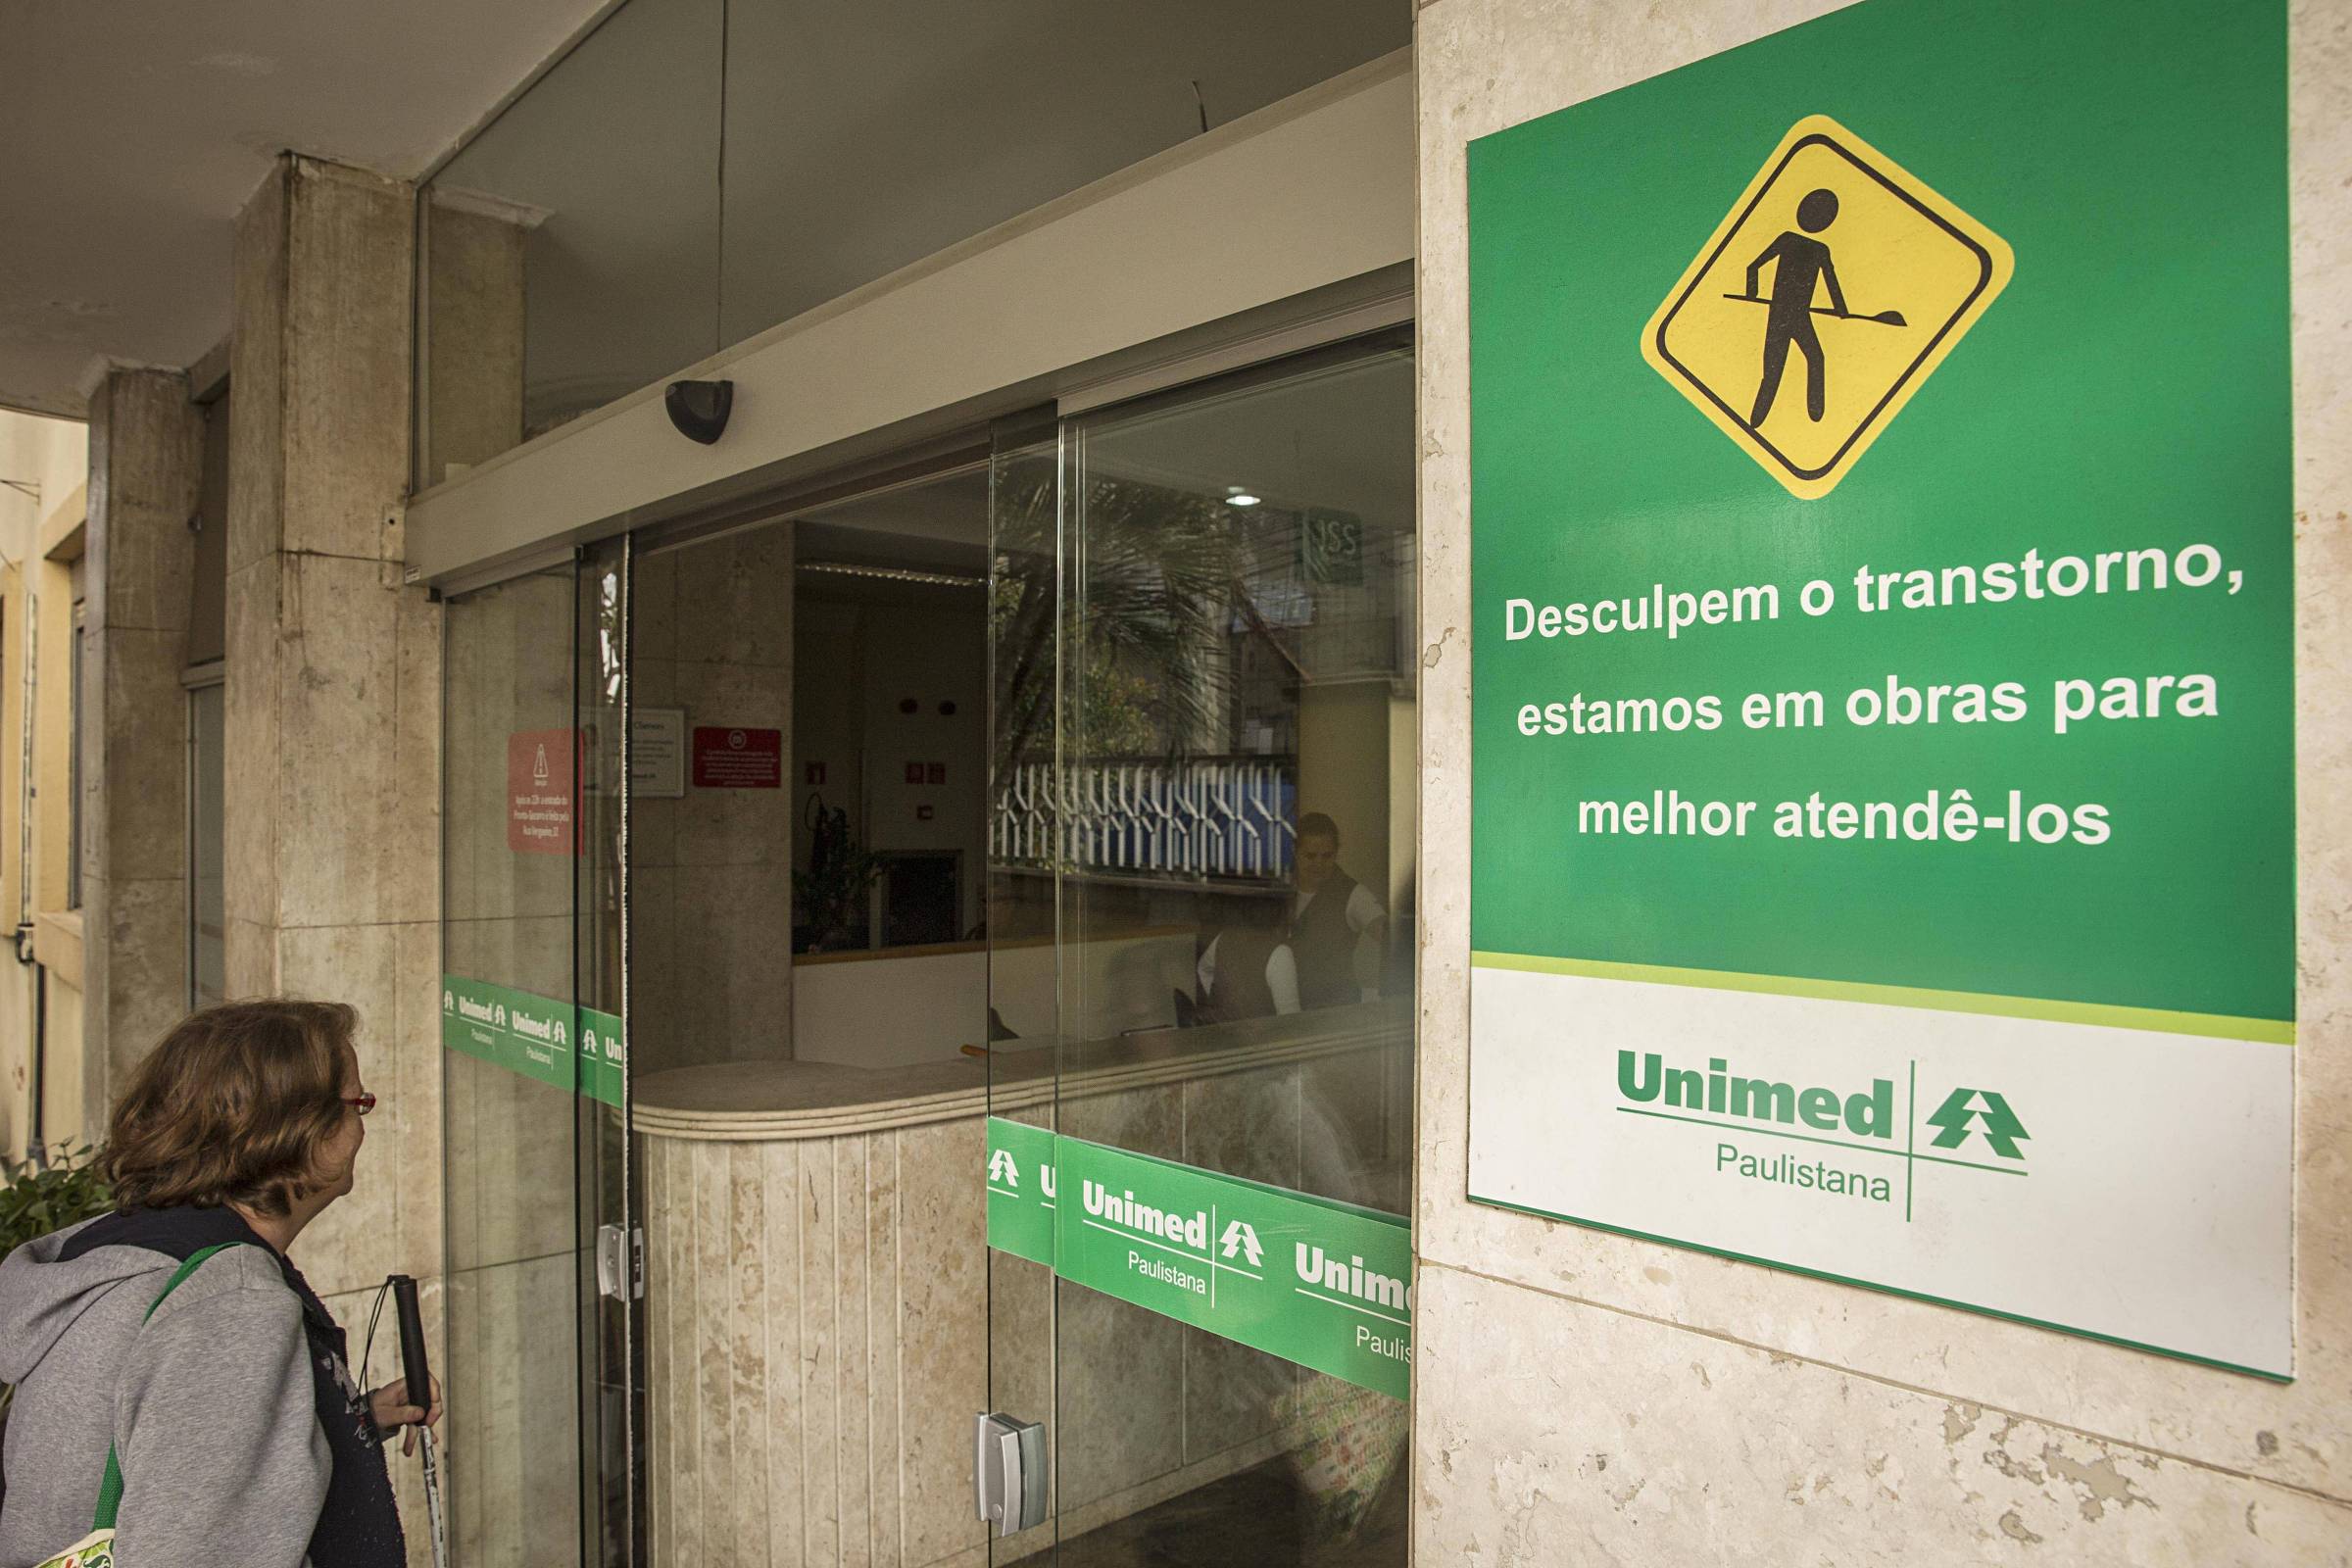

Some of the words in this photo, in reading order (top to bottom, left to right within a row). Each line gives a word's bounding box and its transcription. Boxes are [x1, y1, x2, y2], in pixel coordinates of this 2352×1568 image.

[1505, 584, 1779, 641] Desculpem
[1799, 579, 1835, 616] o
[1854, 543, 2243, 612] transtorno,
[1517, 692, 1723, 736] estamos
[1741, 690, 1824, 729] em
[1845, 674, 2028, 726] obras
[2054, 673, 2219, 735] para
[1579, 789, 1757, 837] melhor
[1773, 788, 2111, 845] atendê-los
[460, 996, 492, 1021] Unimed
[513, 1011, 550, 1038] Unimed
[1617, 1049, 1894, 1140] Unimed
[1716, 1143, 1891, 1202] Paulistana
[1082, 1179, 1207, 1250] Unimed
[1128, 1250, 1206, 1296] Paulistana
[1296, 1242, 1412, 1311] Unim
